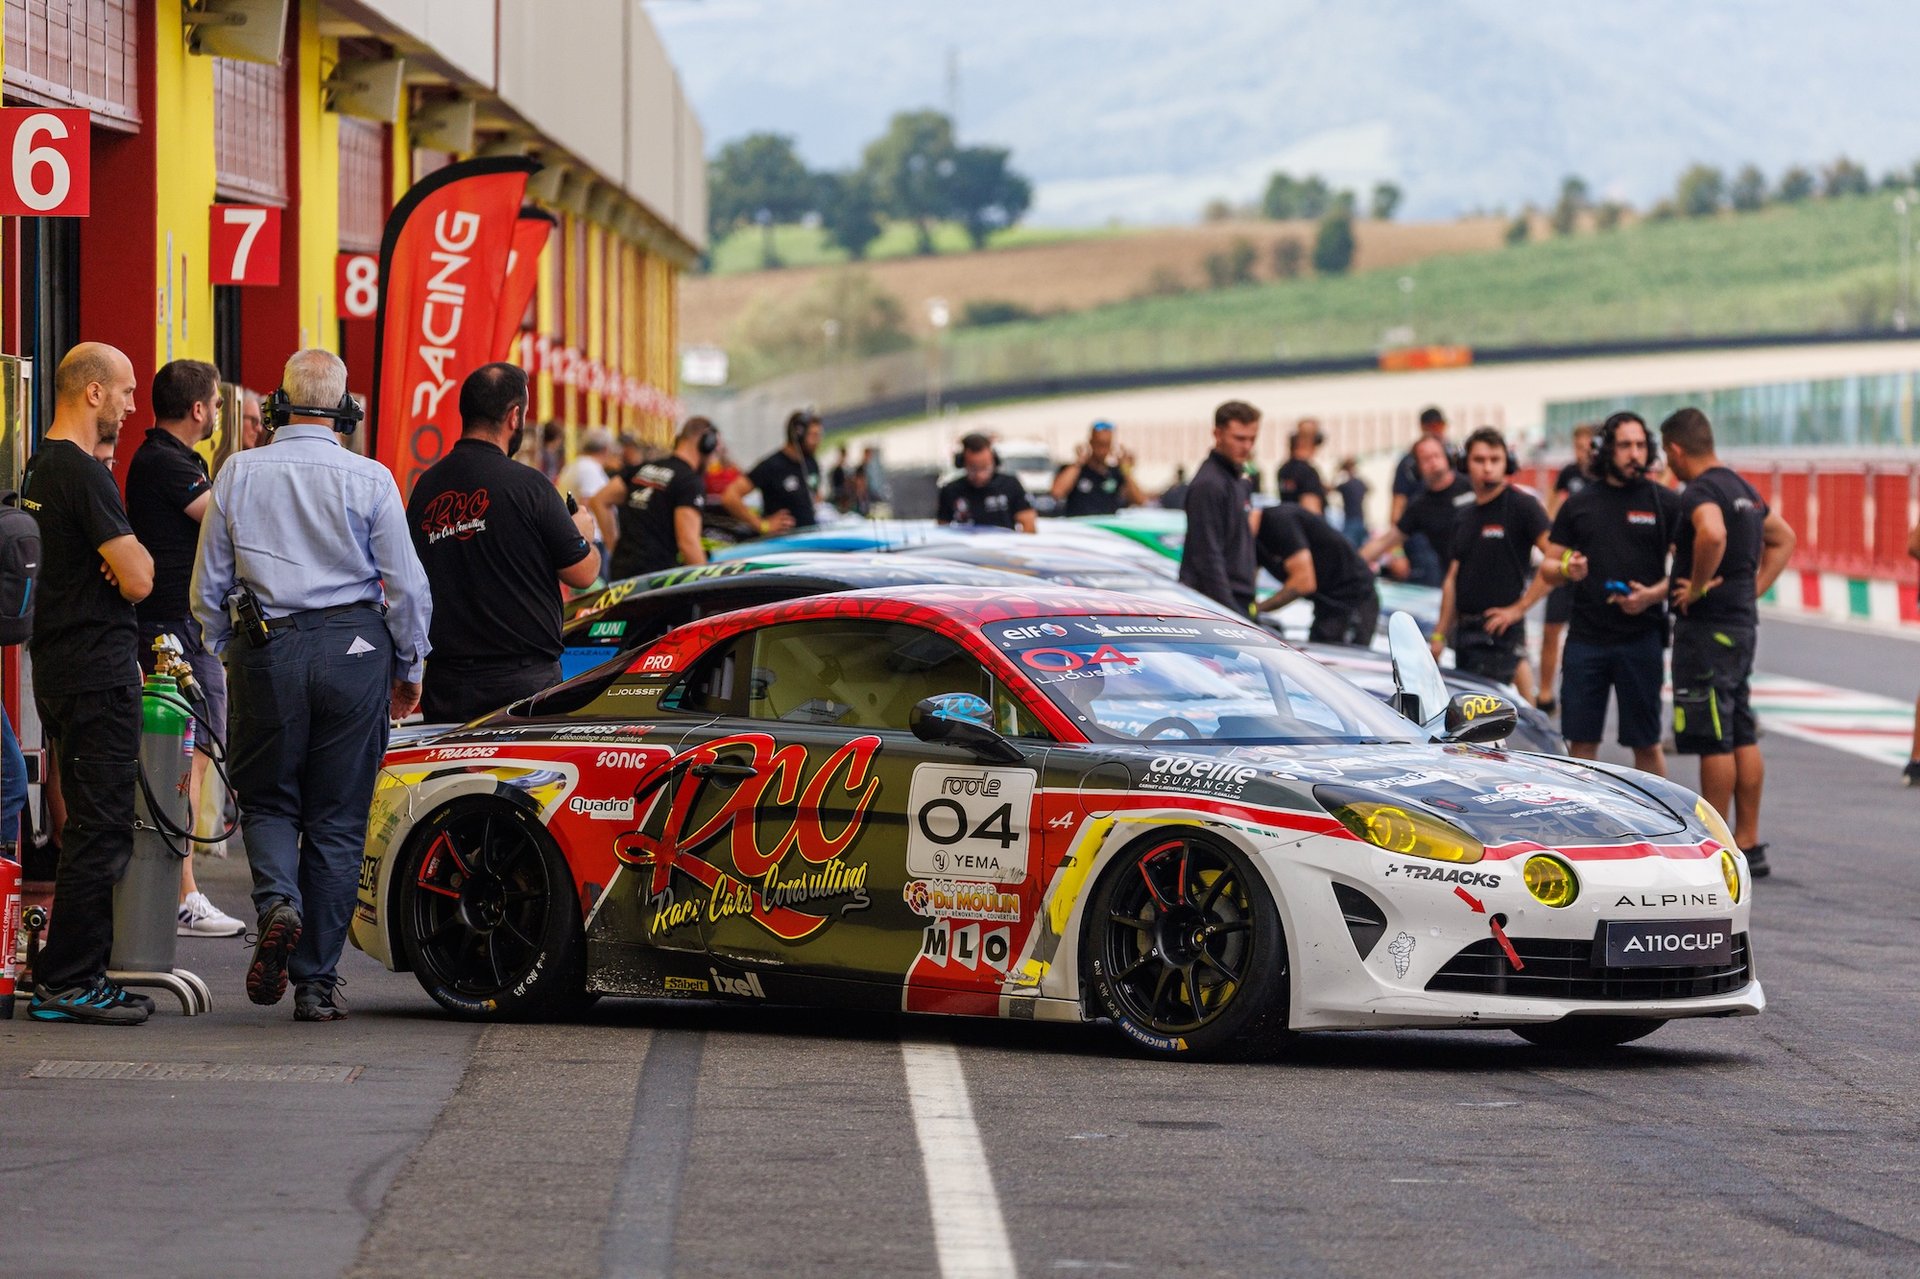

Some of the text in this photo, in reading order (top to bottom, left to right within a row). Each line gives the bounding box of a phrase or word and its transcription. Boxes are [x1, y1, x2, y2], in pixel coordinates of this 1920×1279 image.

[12, 113, 71, 211] 6
[224, 209, 267, 281] 7
[344, 256, 378, 317] 8
[411, 209, 481, 420] RACING
[594, 622, 619, 635] JUN
[1003, 625, 1246, 640] elf MICHELIN elf
[643, 654, 673, 670] PRO
[1021, 644, 1140, 672] 04
[607, 688, 662, 696] L.JOUSSET
[615, 734, 643, 742] peinture
[1150, 756, 1258, 785] abeille
[1141, 772, 1244, 794] ASSURANCES
[918, 798, 1020, 849] 04
[613, 732, 882, 940] RCC
[954, 854, 1000, 870] YEMA
[1403, 864, 1502, 889] TRAACKS
[709, 873, 753, 923] Cars
[761, 858, 871, 915] Consulting
[933, 881, 996, 897] Maçonnerie
[1614, 893, 1718, 907] ALPINE
[933, 890, 1019, 914] Du MOULIN
[987, 913, 1019, 921] COUVERTURE
[1622, 933, 1724, 953] A110CUP
[669, 977, 705, 990] Sabelt
[709, 966, 767, 999] ixell
[1121, 1020, 1169, 1049] MICHELIN
